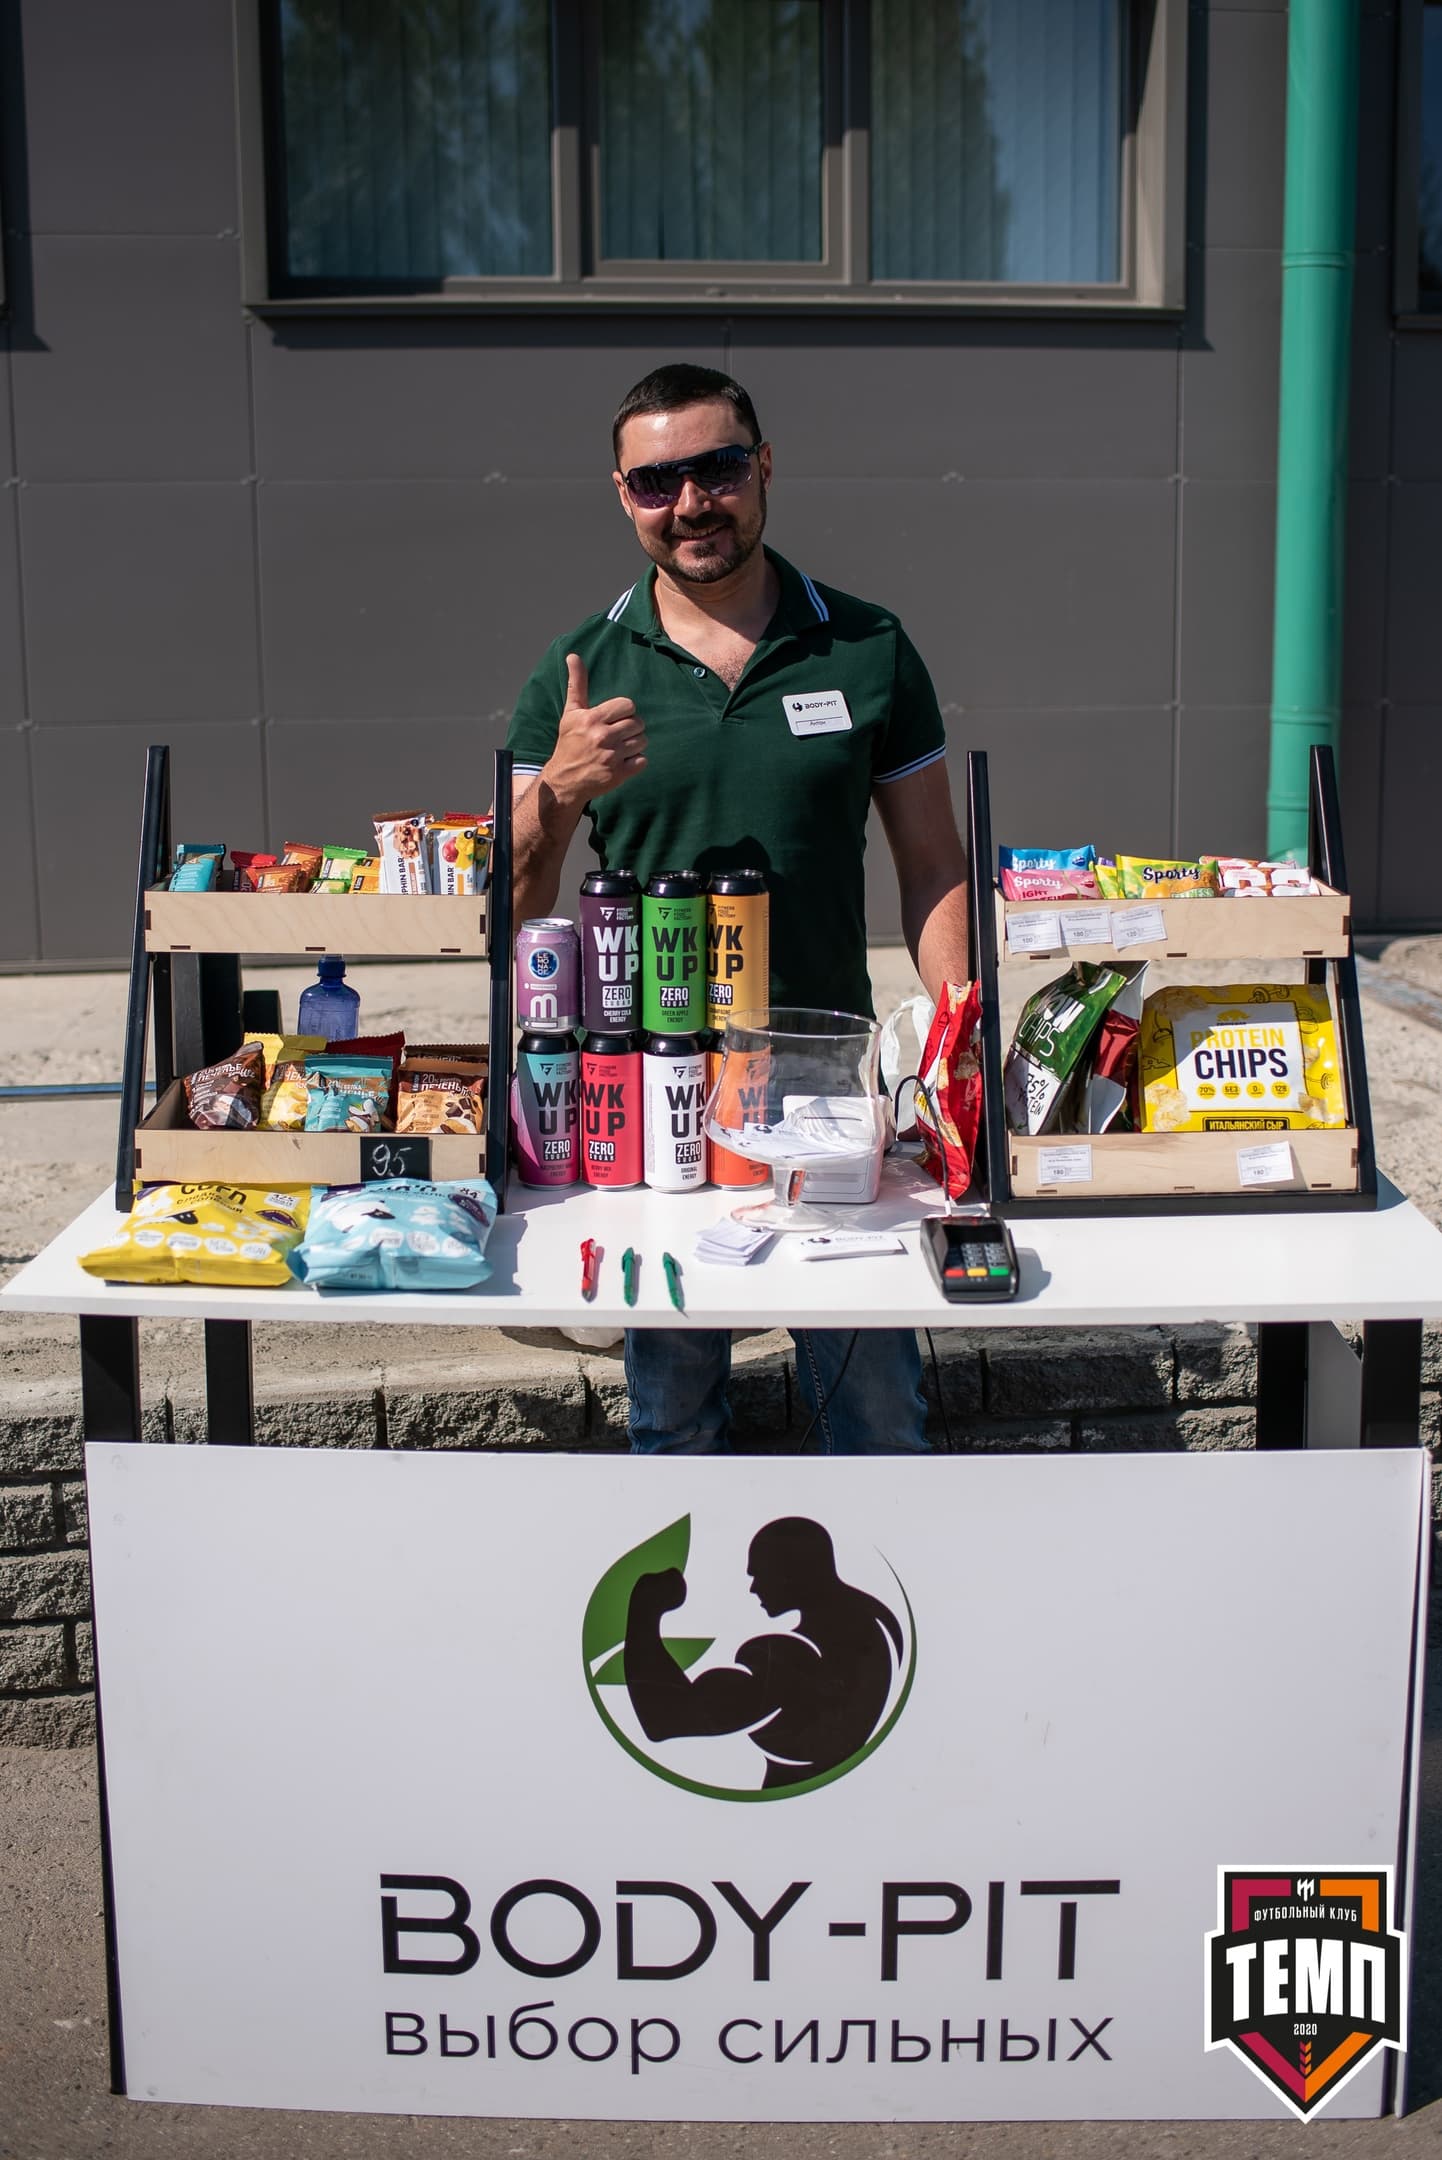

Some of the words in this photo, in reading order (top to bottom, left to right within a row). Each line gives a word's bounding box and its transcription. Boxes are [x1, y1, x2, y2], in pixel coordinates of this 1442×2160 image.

[804, 700, 838, 710] BODY-PIT
[397, 857, 406, 874] BAR
[447, 867, 455, 883] BAR
[1143, 866, 1200, 884] Sporty
[1013, 876, 1064, 889] Sporty
[592, 925, 639, 953] WK
[651, 926, 698, 953] WK
[598, 954, 639, 982] UP
[656, 955, 698, 981] UP
[604, 986, 631, 1001] ZERO
[661, 987, 688, 1001] ZERO
[709, 984, 732, 998] ZERO
[1019, 1012, 1061, 1056] CHIPS
[1190, 1028, 1286, 1049] PROTEIN
[1194, 1048, 1289, 1080] CHIPS
[533, 1080, 577, 1107] WK
[582, 1082, 625, 1109] WK
[665, 1082, 705, 1111] WK
[538, 1108, 577, 1135] UP
[586, 1110, 625, 1136] UP
[1209, 1120, 1265, 1131] ИТАЛЬЯНСКИЙ
[1266, 1120, 1284, 1131] СЫР
[544, 1140, 570, 1154] ZERO
[589, 1141, 614, 1155] ZERO
[677, 1142, 701, 1157] ZERO
[380, 1873, 1121, 1982] BODY-PIT
[384, 2000, 681, 2075] выбор
[717, 2017, 1115, 2064] сильных
